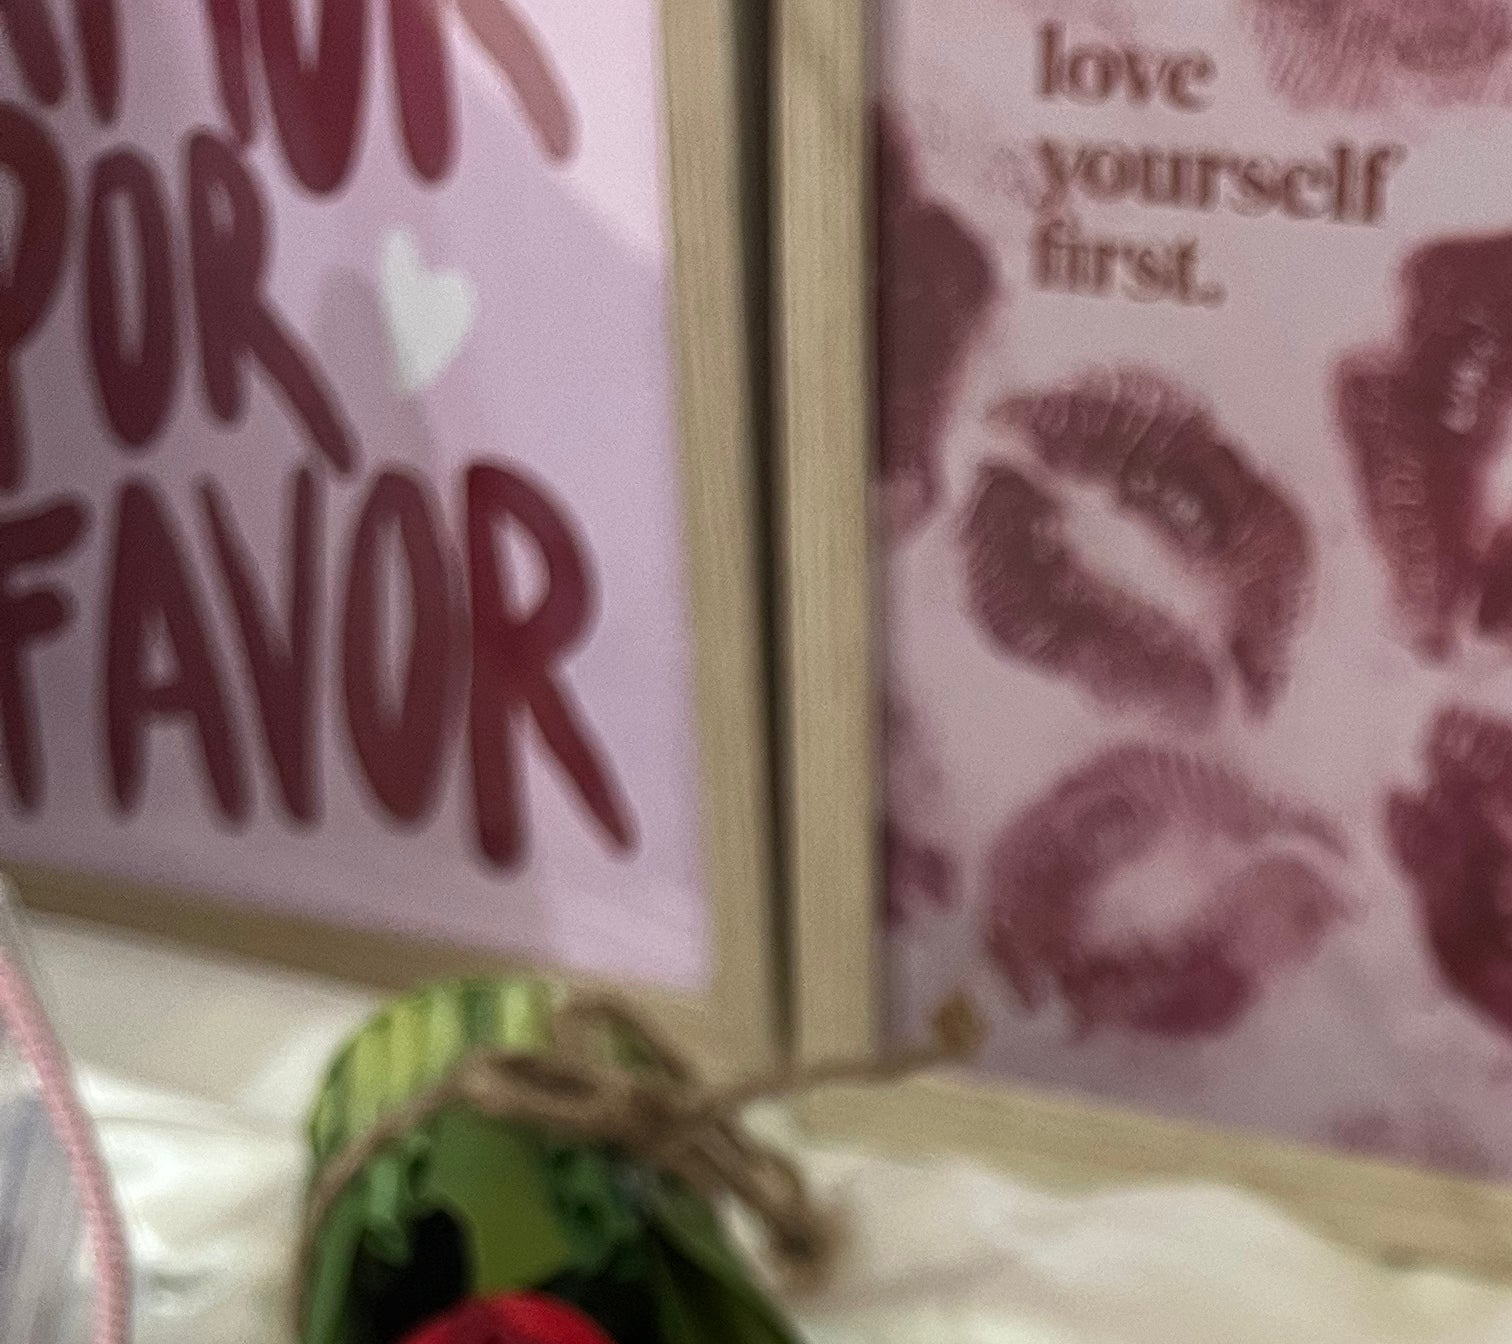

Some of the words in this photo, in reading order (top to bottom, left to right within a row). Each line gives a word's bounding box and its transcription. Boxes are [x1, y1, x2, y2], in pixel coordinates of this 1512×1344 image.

[1035, 20, 1217, 112] love
[1032, 136, 1408, 228] yourself
[1030, 216, 1227, 308] first.
